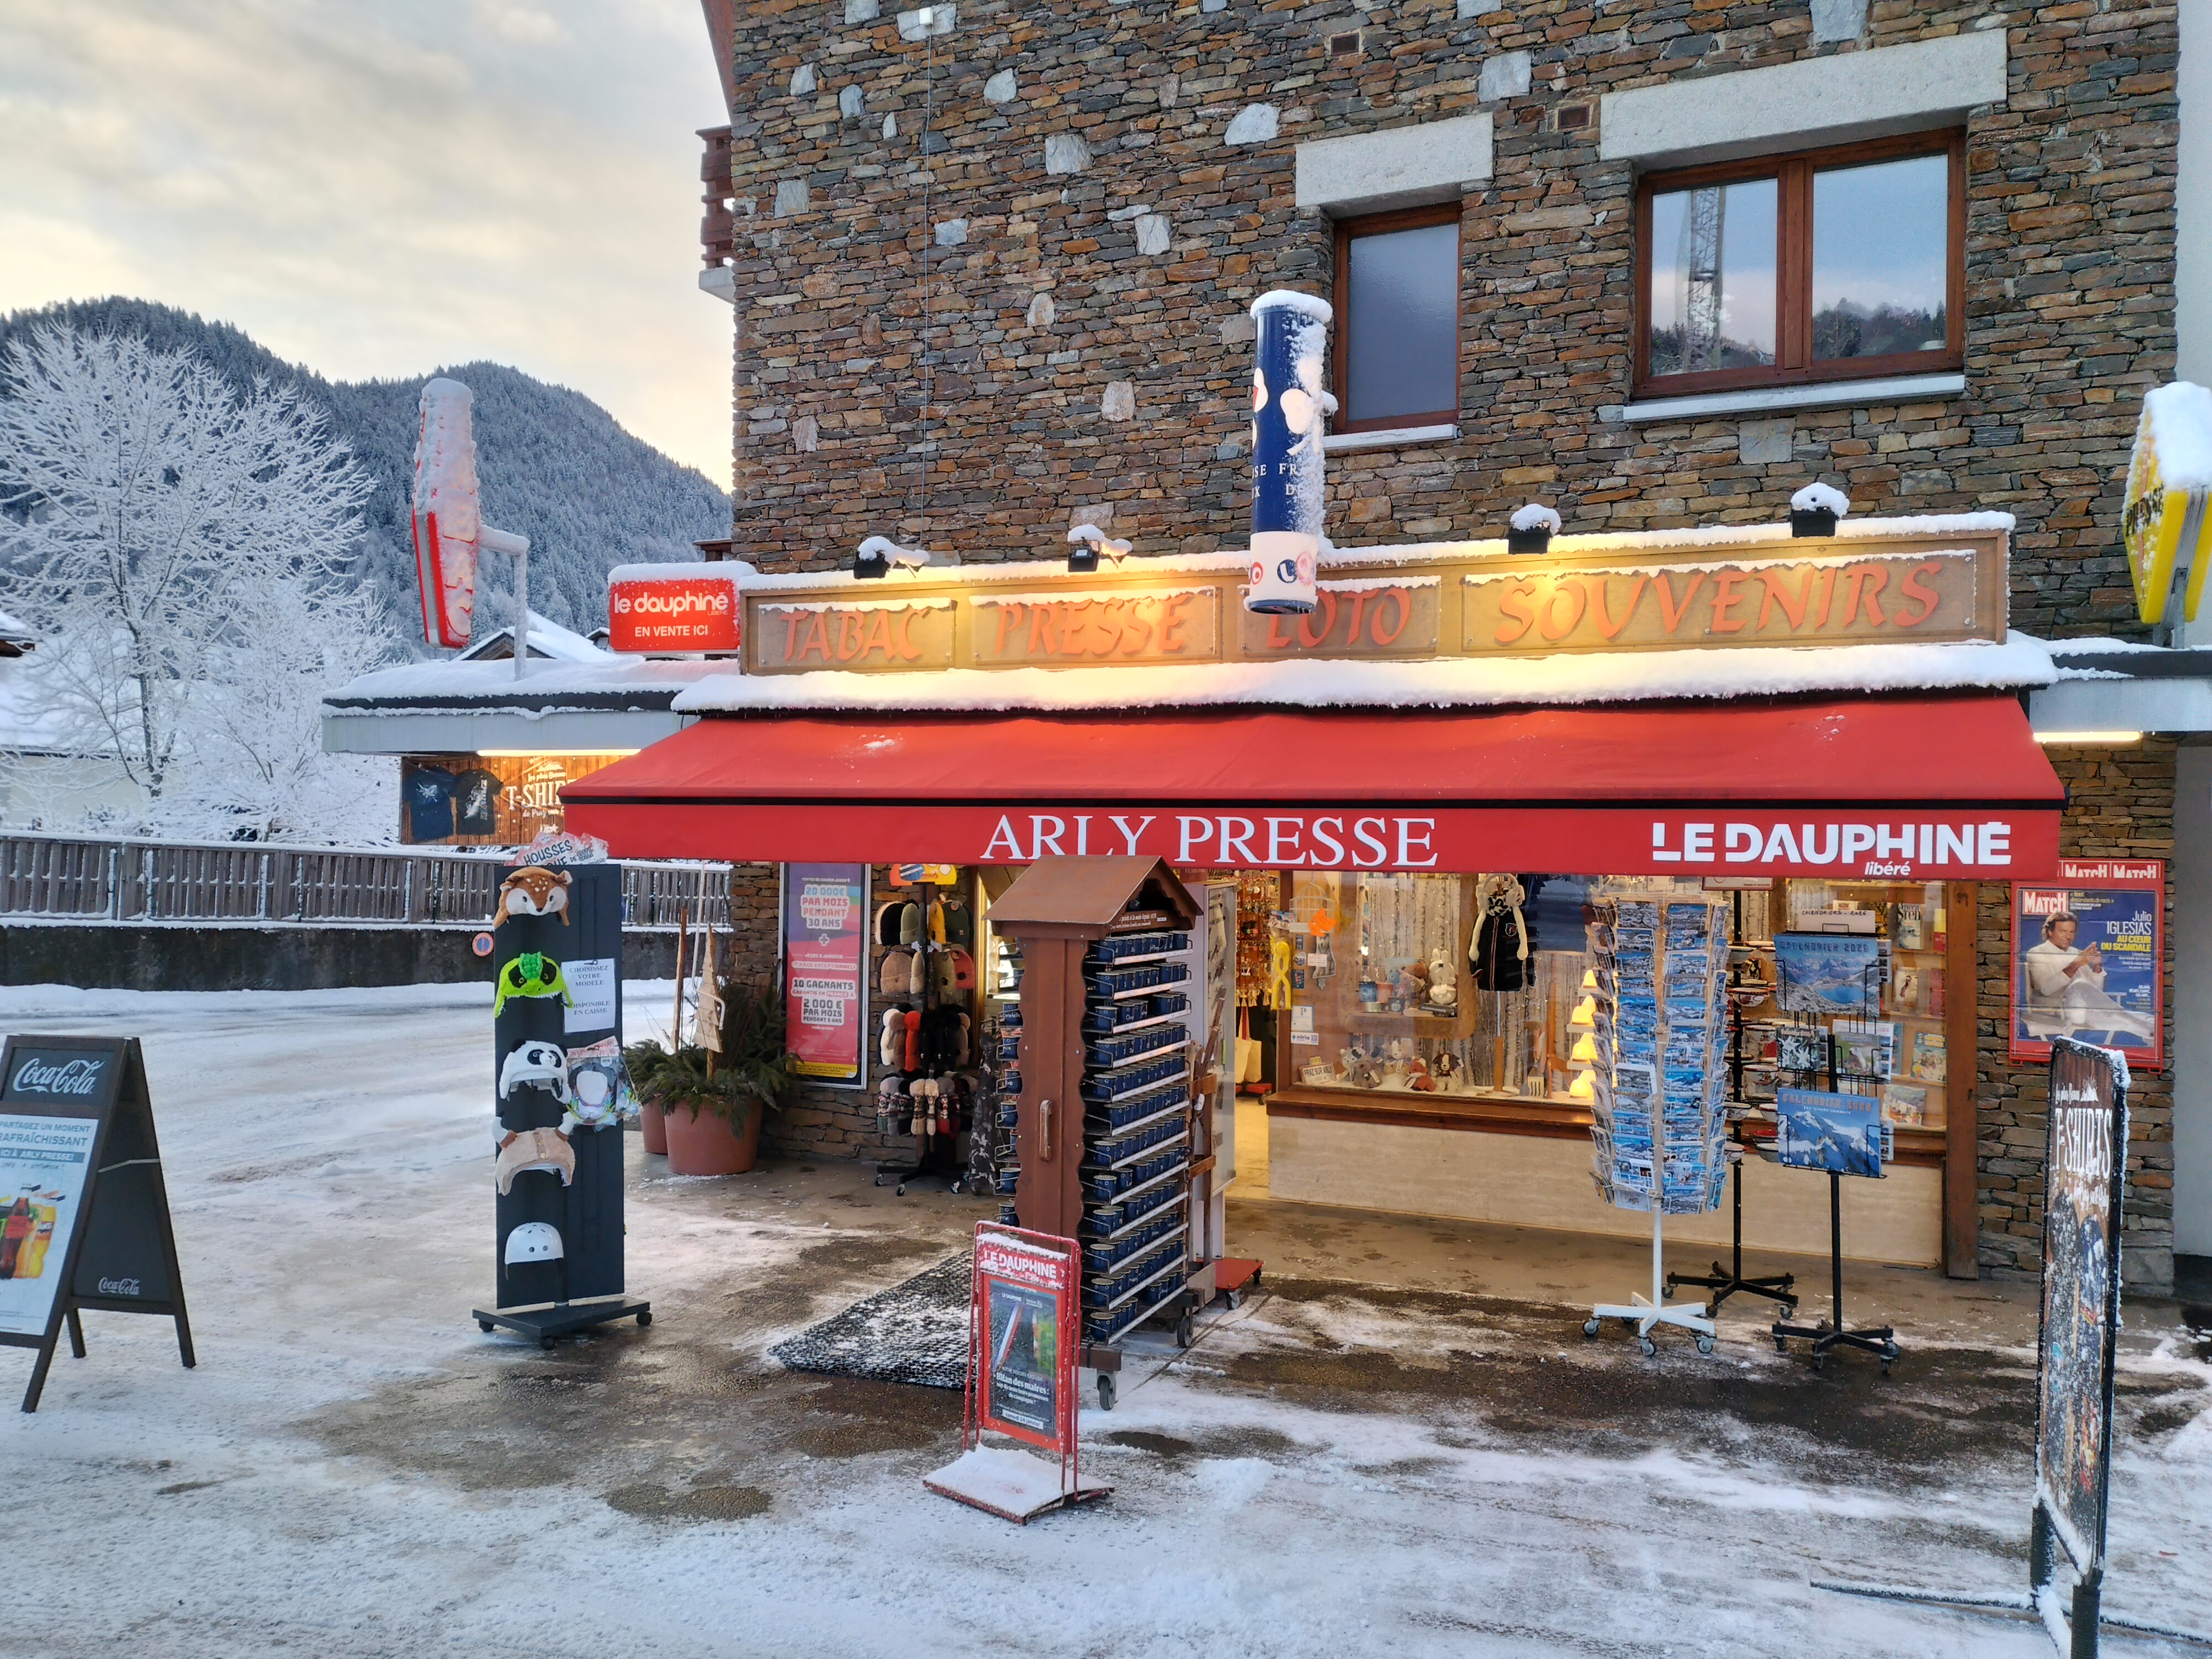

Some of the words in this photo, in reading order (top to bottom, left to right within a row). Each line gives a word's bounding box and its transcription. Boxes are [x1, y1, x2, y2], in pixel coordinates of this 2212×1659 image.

[614, 592, 631, 614] le
[1494, 562, 1943, 643] SOUVENIRS
[635, 627, 650, 637] EN
[653, 625, 691, 637] VENTE
[693, 625, 708, 635] ICI
[995, 593, 1191, 655] PRESSE
[778, 608, 929, 662] TABAC
[505, 779, 577, 811] T-SHIR
[980, 815, 1156, 860] ARLY
[1175, 816, 1438, 867] PRESSE
[1652, 822, 1715, 862] LE
[1725, 821, 2012, 865] DAUPHINÉ
[523, 839, 573, 865] HOUSSES
[576, 848, 593, 862] SKI
[1865, 862, 1911, 877] libéré
[823, 898, 848, 906] MOIS
[2025, 891, 2067, 914] MATCH
[804, 908, 847, 917] PENDANT
[2132, 910, 2152, 922] Julio
[822, 919, 841, 927] ANS
[2106, 921, 2152, 935] IGLESIAS
[1780, 941, 1839, 952] CALENDRIER
[1844, 943, 1869, 953] 2026
[2101, 942, 2112, 951] DU
[2113, 943, 2151, 952] SCANDALE
[794, 979, 804, 988] 10
[806, 980, 854, 990] GAGNANTS
[572, 1000, 610, 1008] DISPONIBLE
[804, 999, 809, 1008] 2
[812, 999, 833, 1009] 000
[13, 1057, 106, 1095] Coca-Cola
[1783, 1093, 1842, 1109] CALENDRIER
[0, 1121, 39, 1131] PARTAGEZ
[54, 1124, 91, 1133] MOMENT
[2055, 1107, 2113, 1180] T-SHIRTS
[19, 1150, 40, 1160] ARLY
[999, 1253, 1057, 1279] DAUPHINÉ
[98, 1276, 140, 1295] Coca-Cola
[997, 1371, 1013, 1384] Bilan
[1013, 1378, 1024, 1387] des
